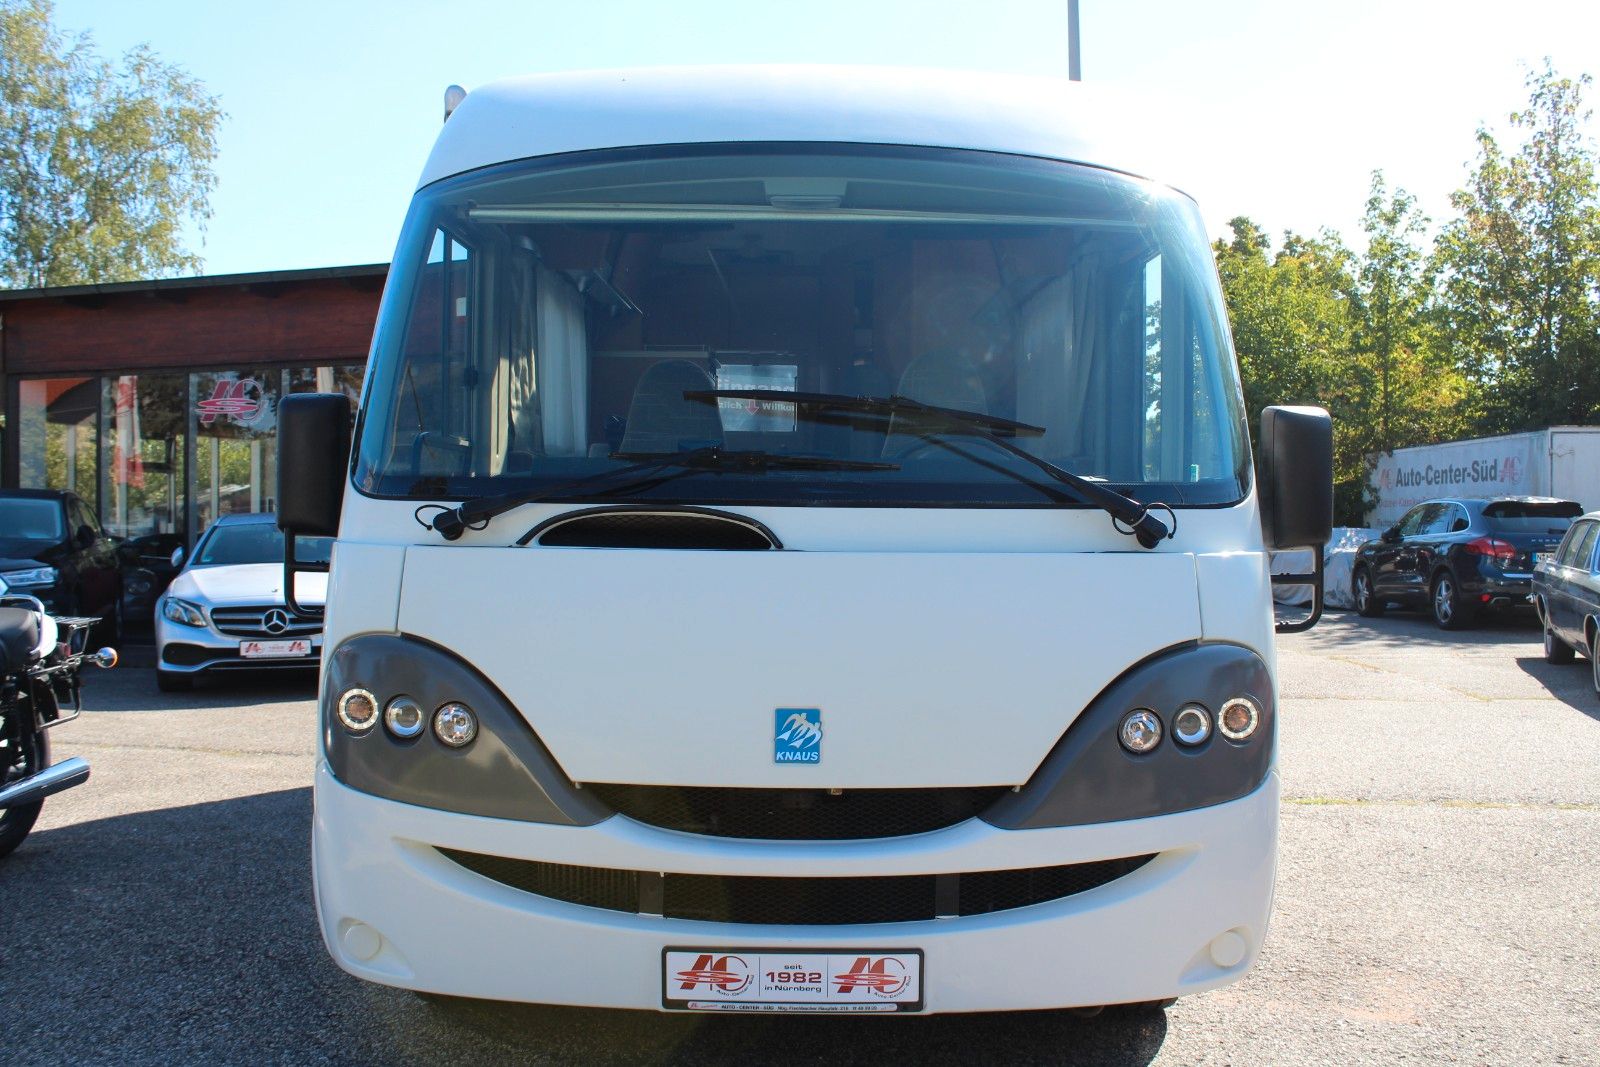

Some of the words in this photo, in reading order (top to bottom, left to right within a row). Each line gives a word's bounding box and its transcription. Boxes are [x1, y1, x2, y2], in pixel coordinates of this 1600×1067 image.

[1395, 458, 1498, 487] Auto-Center-Süd
[776, 751, 819, 761] KNAUS
[766, 971, 822, 983] 1982
[774, 984, 822, 993] Nürnberg
